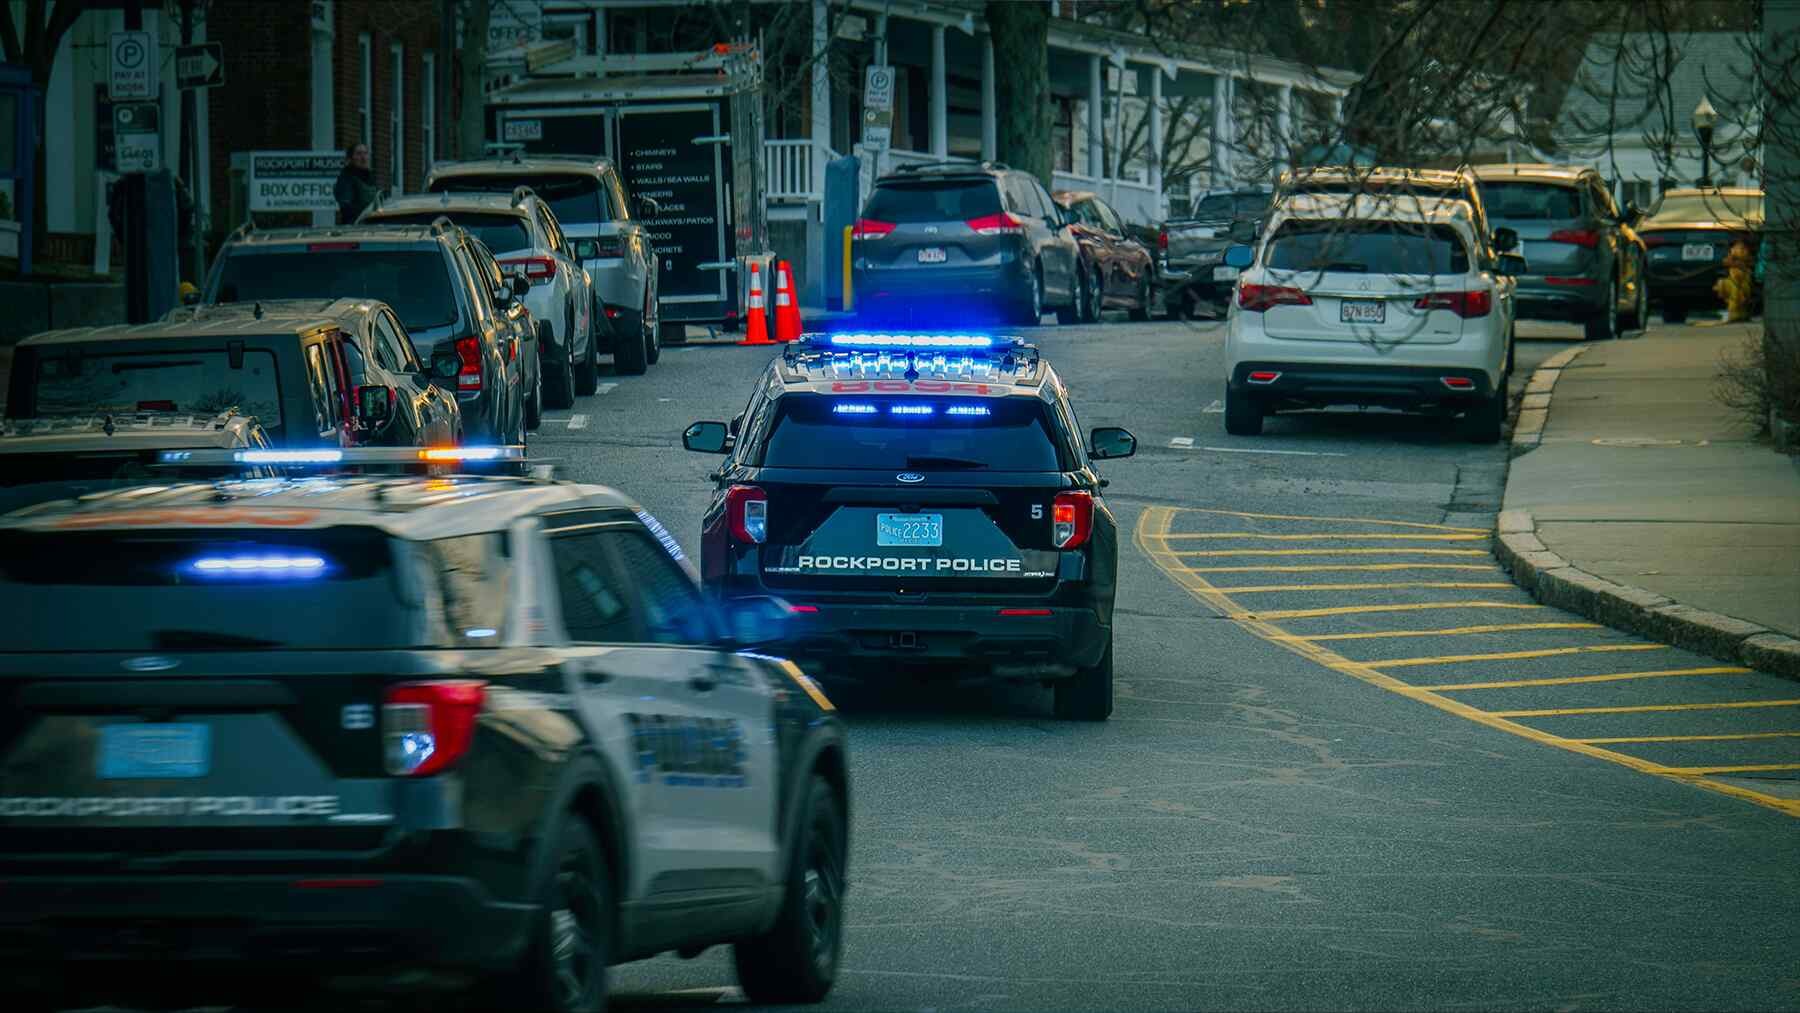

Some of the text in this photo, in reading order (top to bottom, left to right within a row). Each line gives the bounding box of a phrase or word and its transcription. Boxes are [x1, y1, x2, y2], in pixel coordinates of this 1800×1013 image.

[114, 72, 145, 80] PAY AT
[635, 148, 677, 157] CHIMNEYS
[257, 159, 345, 169] ROCKPORT MUSIC
[636, 163, 663, 171] STAIRS
[682, 175, 710, 183] WALLS
[260, 183, 337, 197] BOX OFFIC
[1031, 504, 1043, 520] 5
[903, 522, 939, 539] 2233
[798, 556, 1021, 572] ROCKPORT POLICE
[0, 795, 339, 817] OCKPORT POLICE
